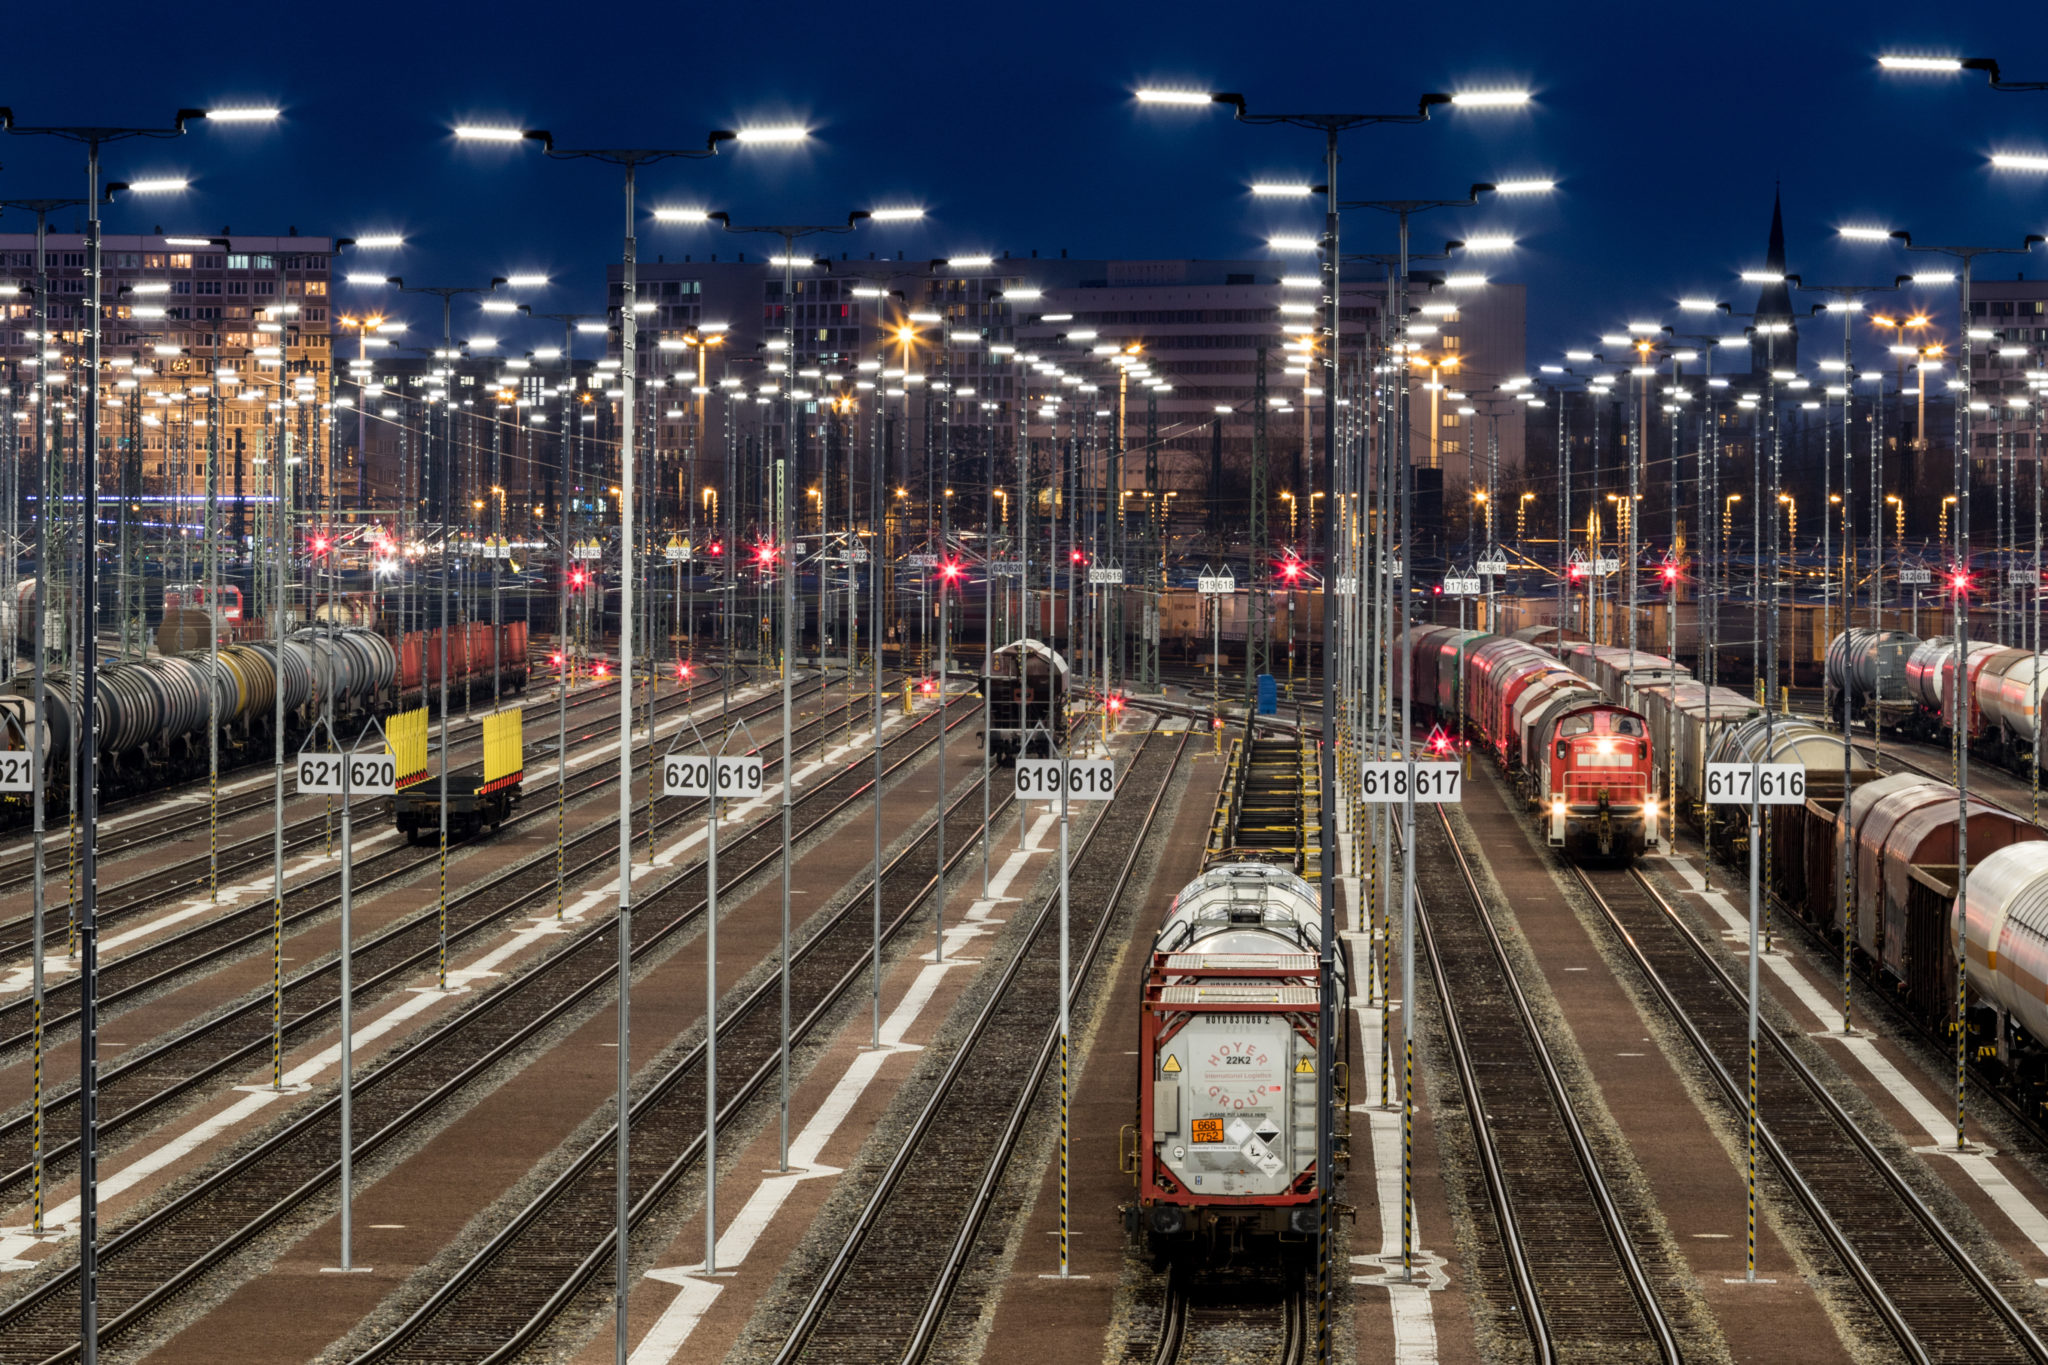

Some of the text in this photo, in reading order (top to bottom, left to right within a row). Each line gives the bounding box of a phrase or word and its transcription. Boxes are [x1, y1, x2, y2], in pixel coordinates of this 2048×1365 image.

[1107, 571, 1122, 580] 619
[1493, 563, 1506, 571] 614
[1200, 580, 1215, 590] 619
[1218, 580, 1233, 590] 618
[1901, 572, 1914, 581] 612
[1917, 572, 1930, 581] 611
[2025, 573, 2034, 581] 61
[1445, 582, 1460, 591] 617
[1463, 582, 1480, 591] 616
[0, 759, 30, 783] 21
[301, 761, 341, 786] 621
[351, 762, 394, 787] 620
[666, 763, 709, 788] 620
[718, 765, 761, 789] 619
[1017, 767, 1061, 792] 619
[1069, 767, 1113, 792] 618
[1364, 770, 1407, 795] 618
[1416, 770, 1460, 795] 617
[1708, 771, 1752, 796] 617
[1760, 772, 1804, 797] 616
[1265, 1015, 1270, 1024] 2
[1208, 1042, 1268, 1067] HOYER
[1226, 1056, 1251, 1065] 22K2
[1208, 1085, 1266, 1110] GROUP
[1197, 1120, 1216, 1130] 668
[1196, 1131, 1218, 1141] 1752
